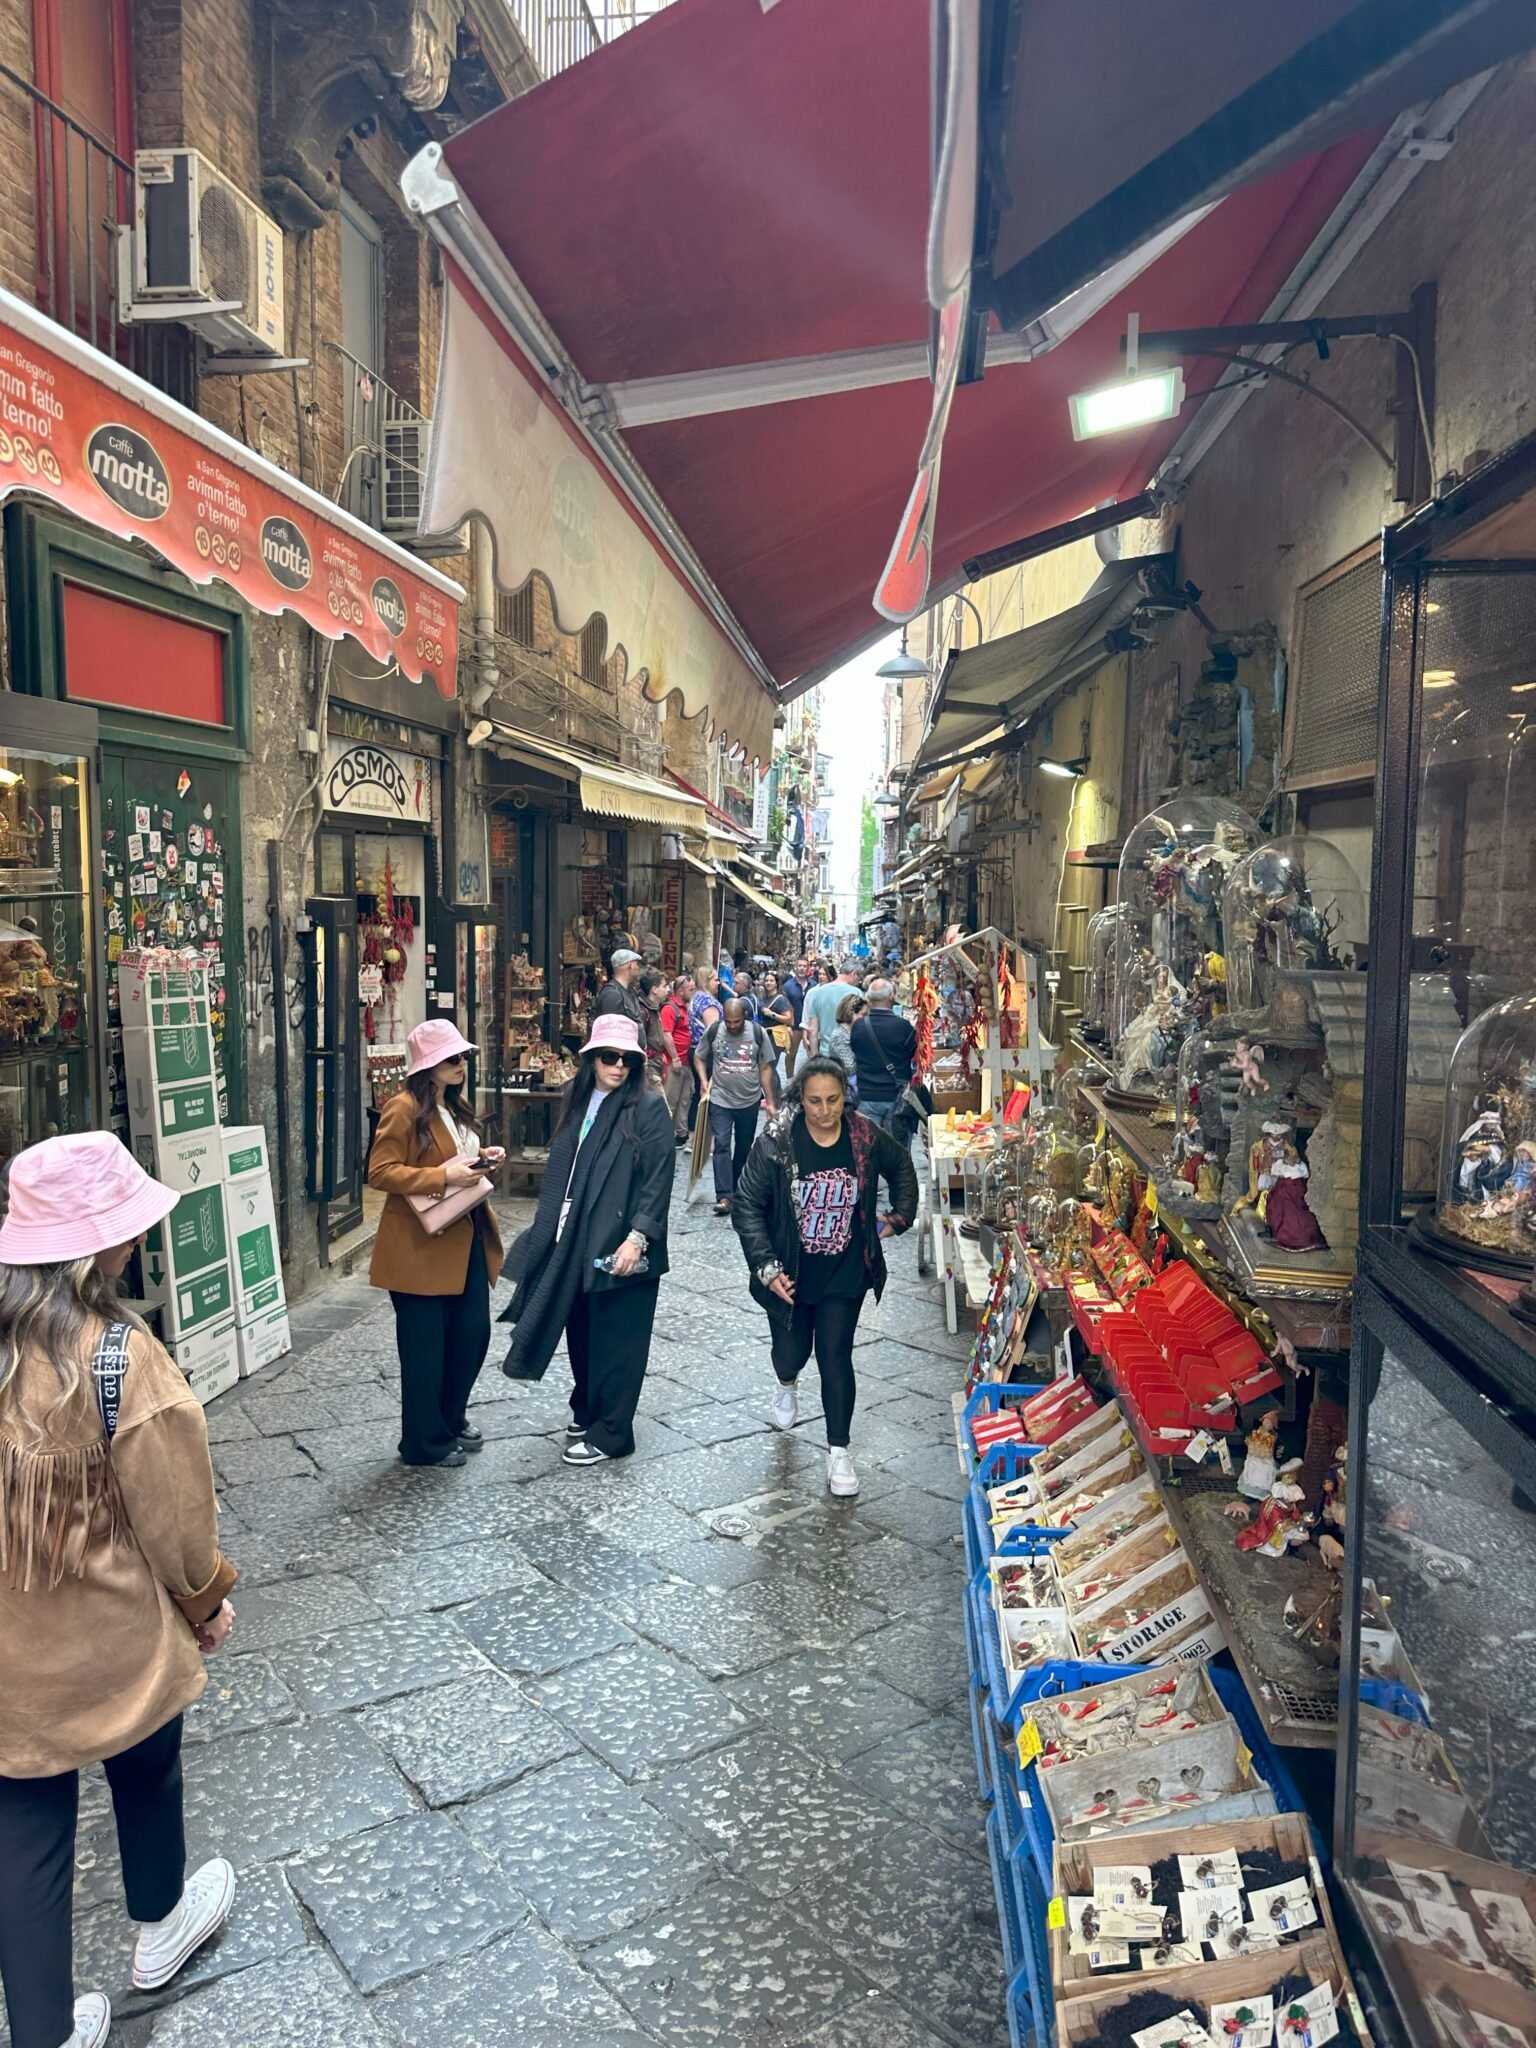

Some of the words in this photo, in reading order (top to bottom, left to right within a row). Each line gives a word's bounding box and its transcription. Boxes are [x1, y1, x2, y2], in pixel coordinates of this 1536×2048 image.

[0, 347, 13, 362] an
[15, 351, 55, 387] Gregorio
[0, 368, 26, 401] mm
[30, 380, 64, 421] fatto
[0, 391, 53, 440] 'terno!
[14, 437, 37, 470] 25
[41, 452, 60, 483] 42
[109, 435, 134, 458] caffè
[92, 447, 169, 508] motta
[187, 475, 224, 506] avimm
[224, 490, 247, 518] fatto
[202, 461, 215, 477] San
[215, 468, 240, 493] Gregorio
[229, 542, 240, 568] 42
[263, 538, 312, 579] motta
[330, 750, 406, 808] COSMOS
[663, 879, 680, 971] FERRIGN
[177, 1145, 207, 1161] PROMETAL
[806, 1211, 853, 1240] IF
[104, 1345, 119, 1399] GUESS
[108, 1404, 119, 1432] 1981
[1111, 1606, 1187, 1662] STORAGE
